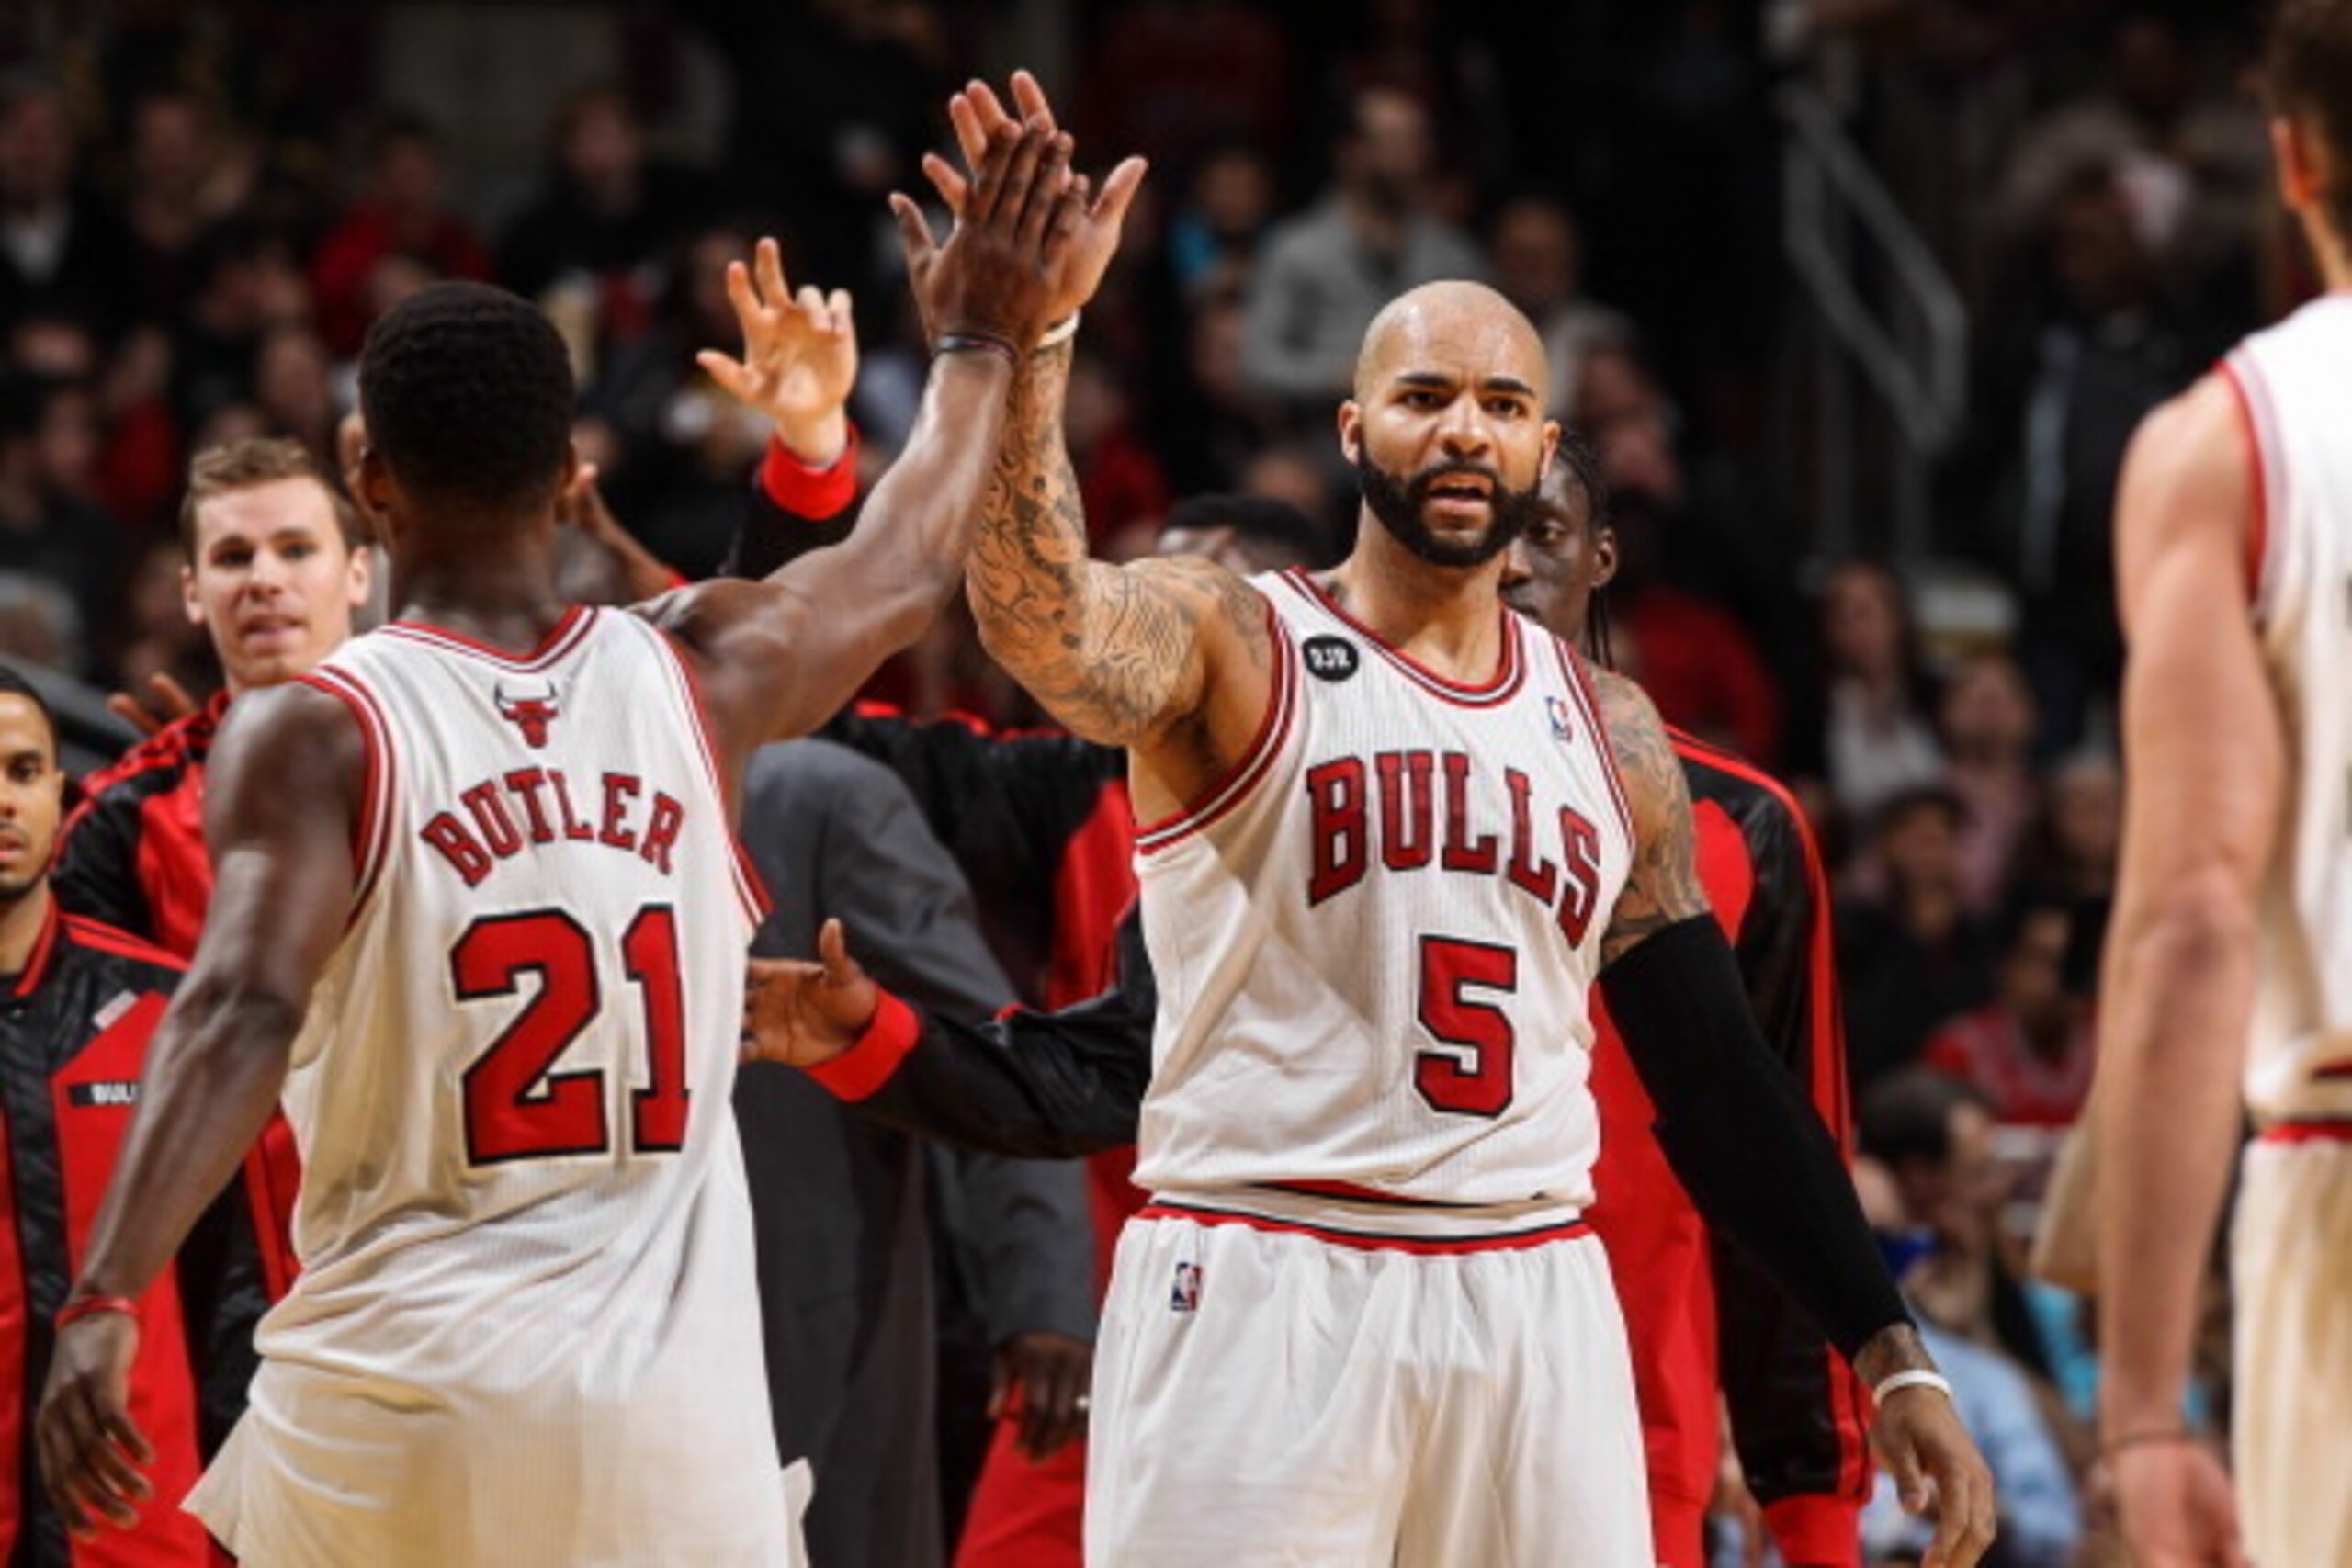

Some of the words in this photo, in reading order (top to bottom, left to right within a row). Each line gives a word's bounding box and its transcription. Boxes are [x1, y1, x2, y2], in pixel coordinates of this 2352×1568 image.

[420, 767, 685, 887] BUTLER
[1306, 750, 1600, 950] BULLS
[450, 903, 689, 1166] 21
[1414, 933, 1517, 1119] 5
